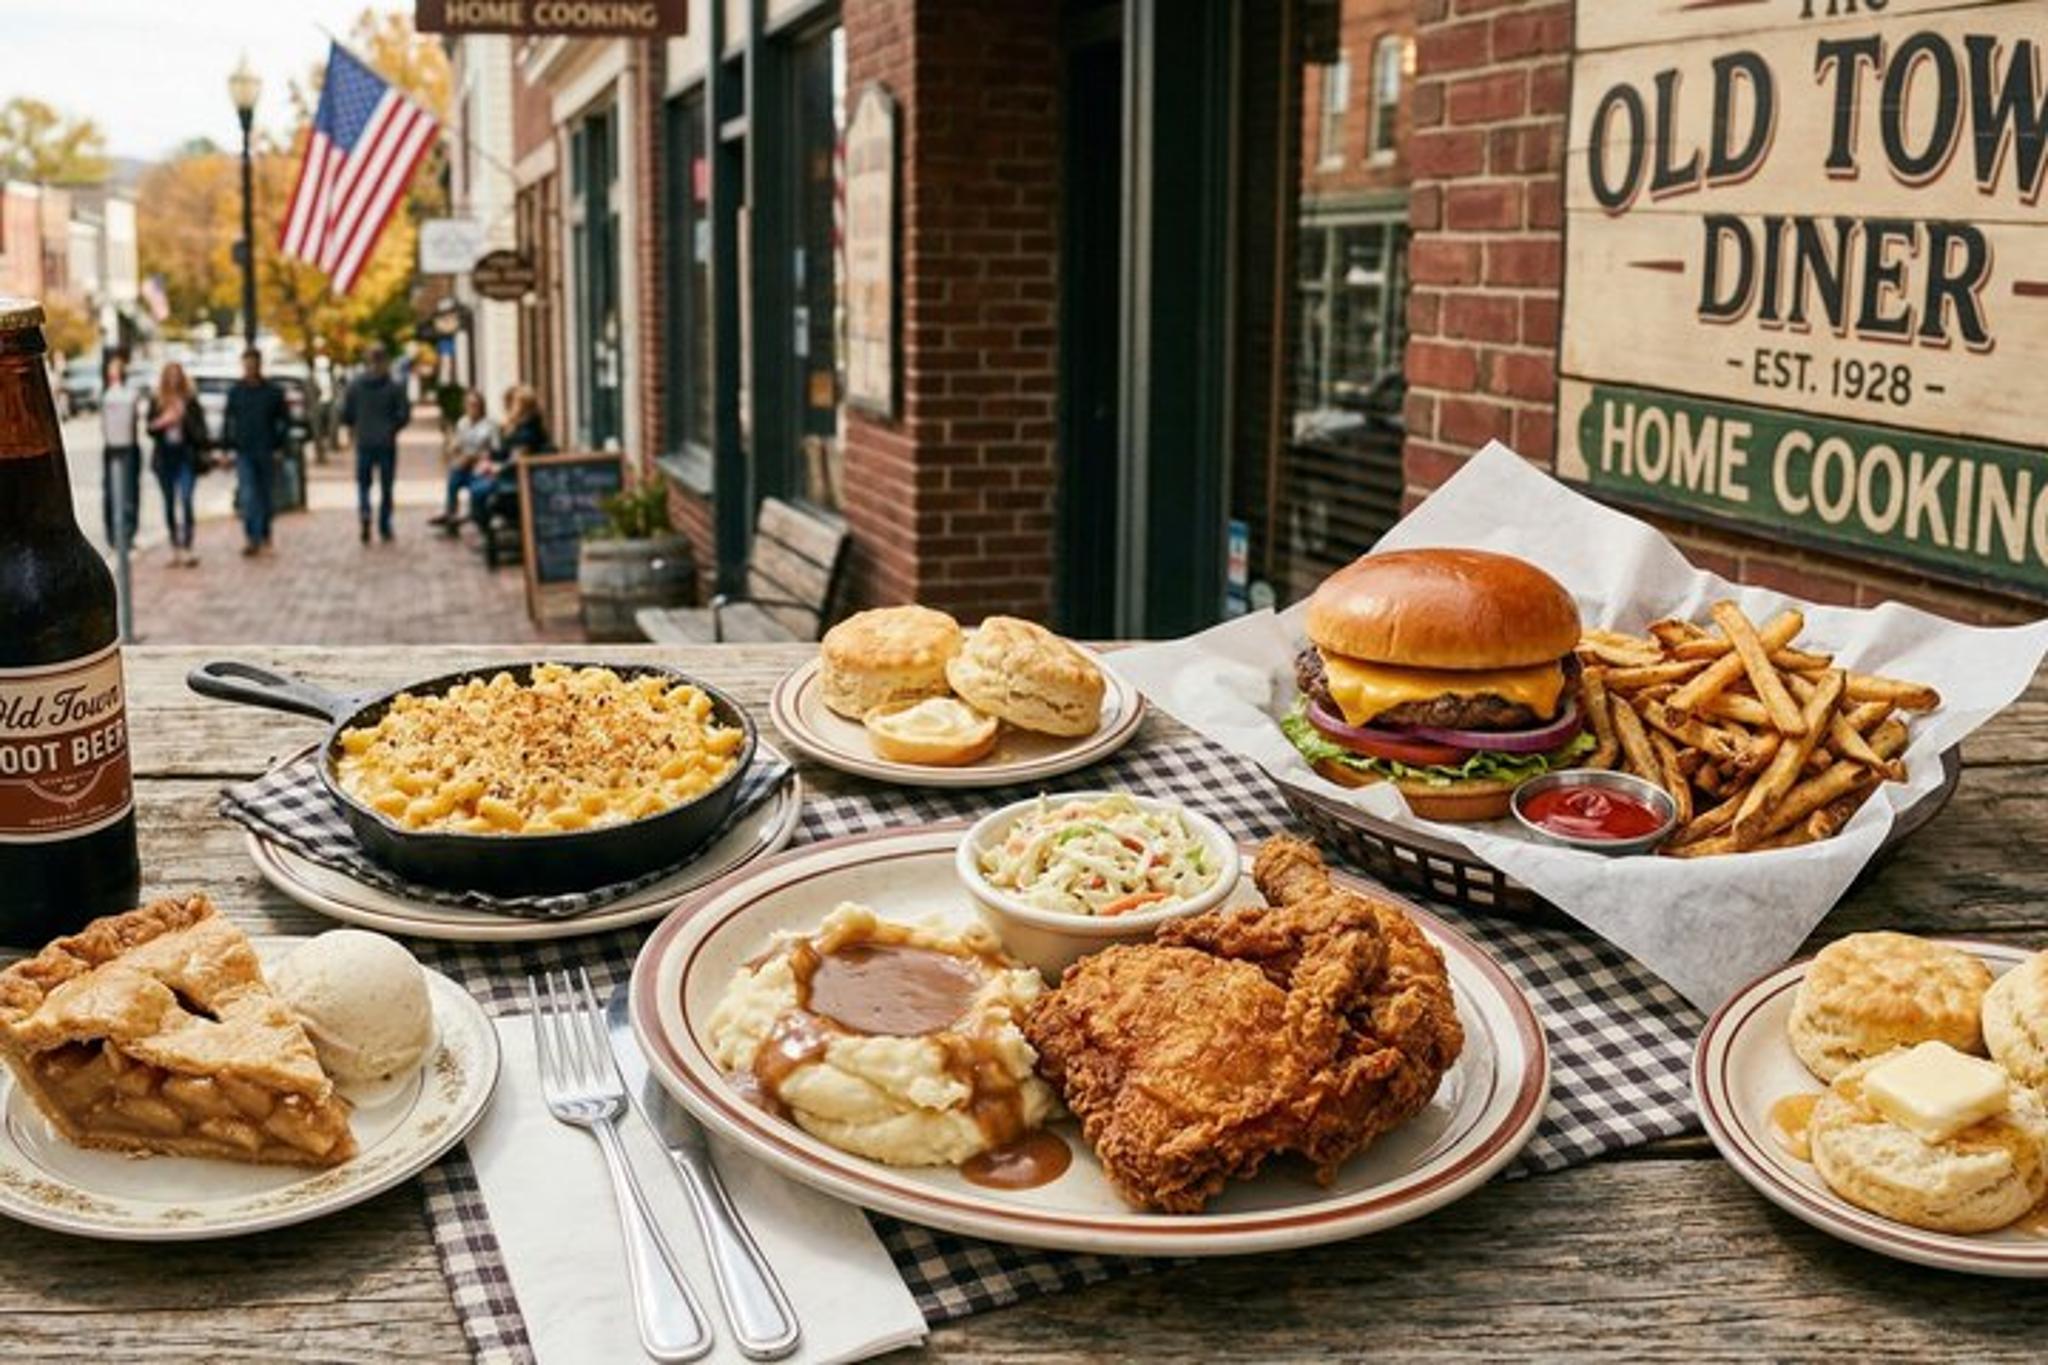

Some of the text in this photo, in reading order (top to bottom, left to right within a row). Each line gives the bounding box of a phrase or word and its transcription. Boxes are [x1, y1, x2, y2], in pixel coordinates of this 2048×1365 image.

[446, 1, 658, 27] HOME COOKING
[1588, 50, 1779, 217] OLD
[1697, 214, 1996, 355] DINER
[1753, 348, 1912, 407] EST. 1928
[1602, 400, 1752, 502] HOME
